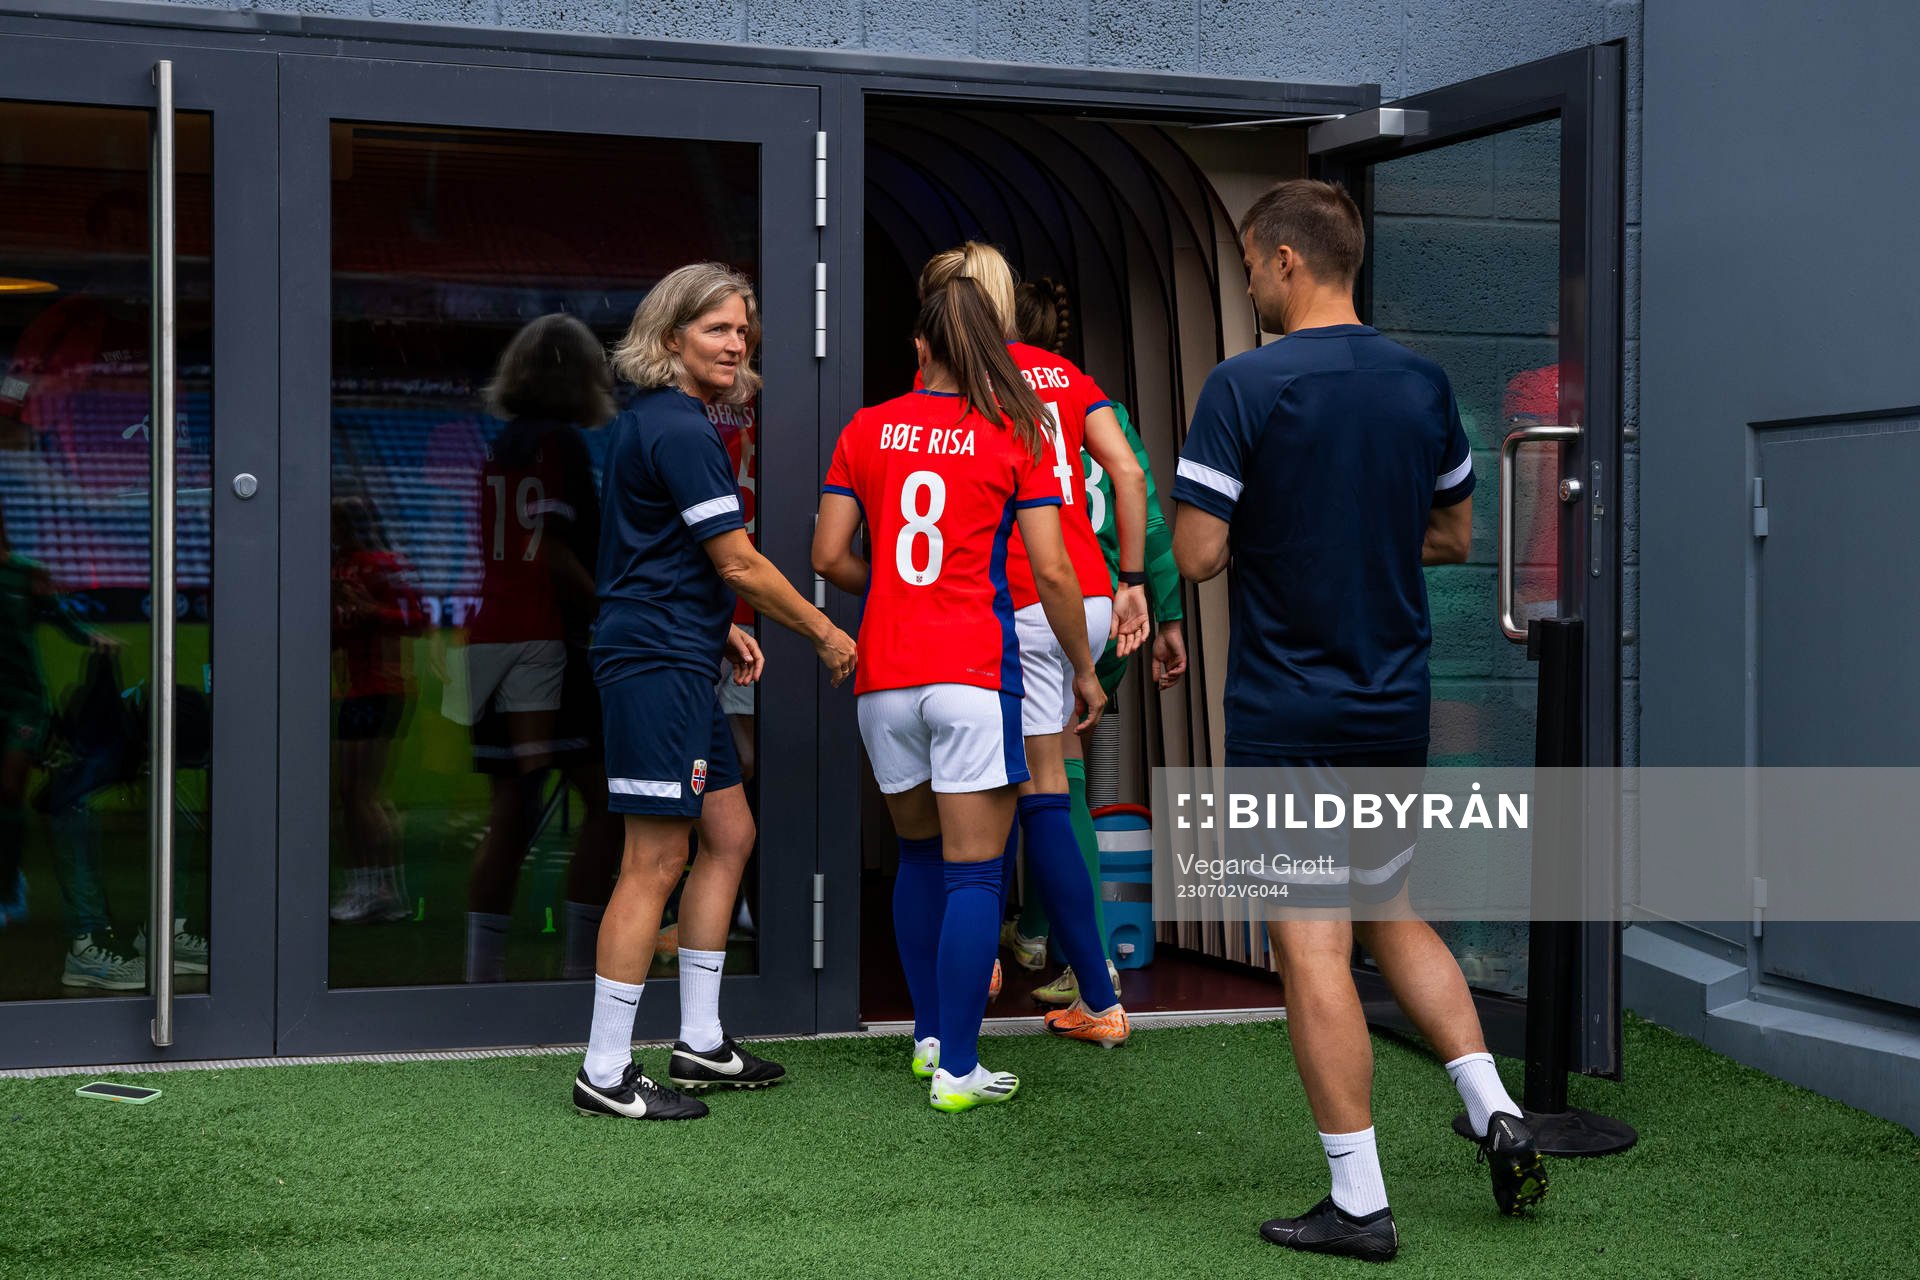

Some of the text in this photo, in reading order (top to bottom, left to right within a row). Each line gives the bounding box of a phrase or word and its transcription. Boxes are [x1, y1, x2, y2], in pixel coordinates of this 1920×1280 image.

[880, 423, 975, 456] BØE RISA
[486, 475, 545, 562] 19
[895, 470, 946, 586] 8
